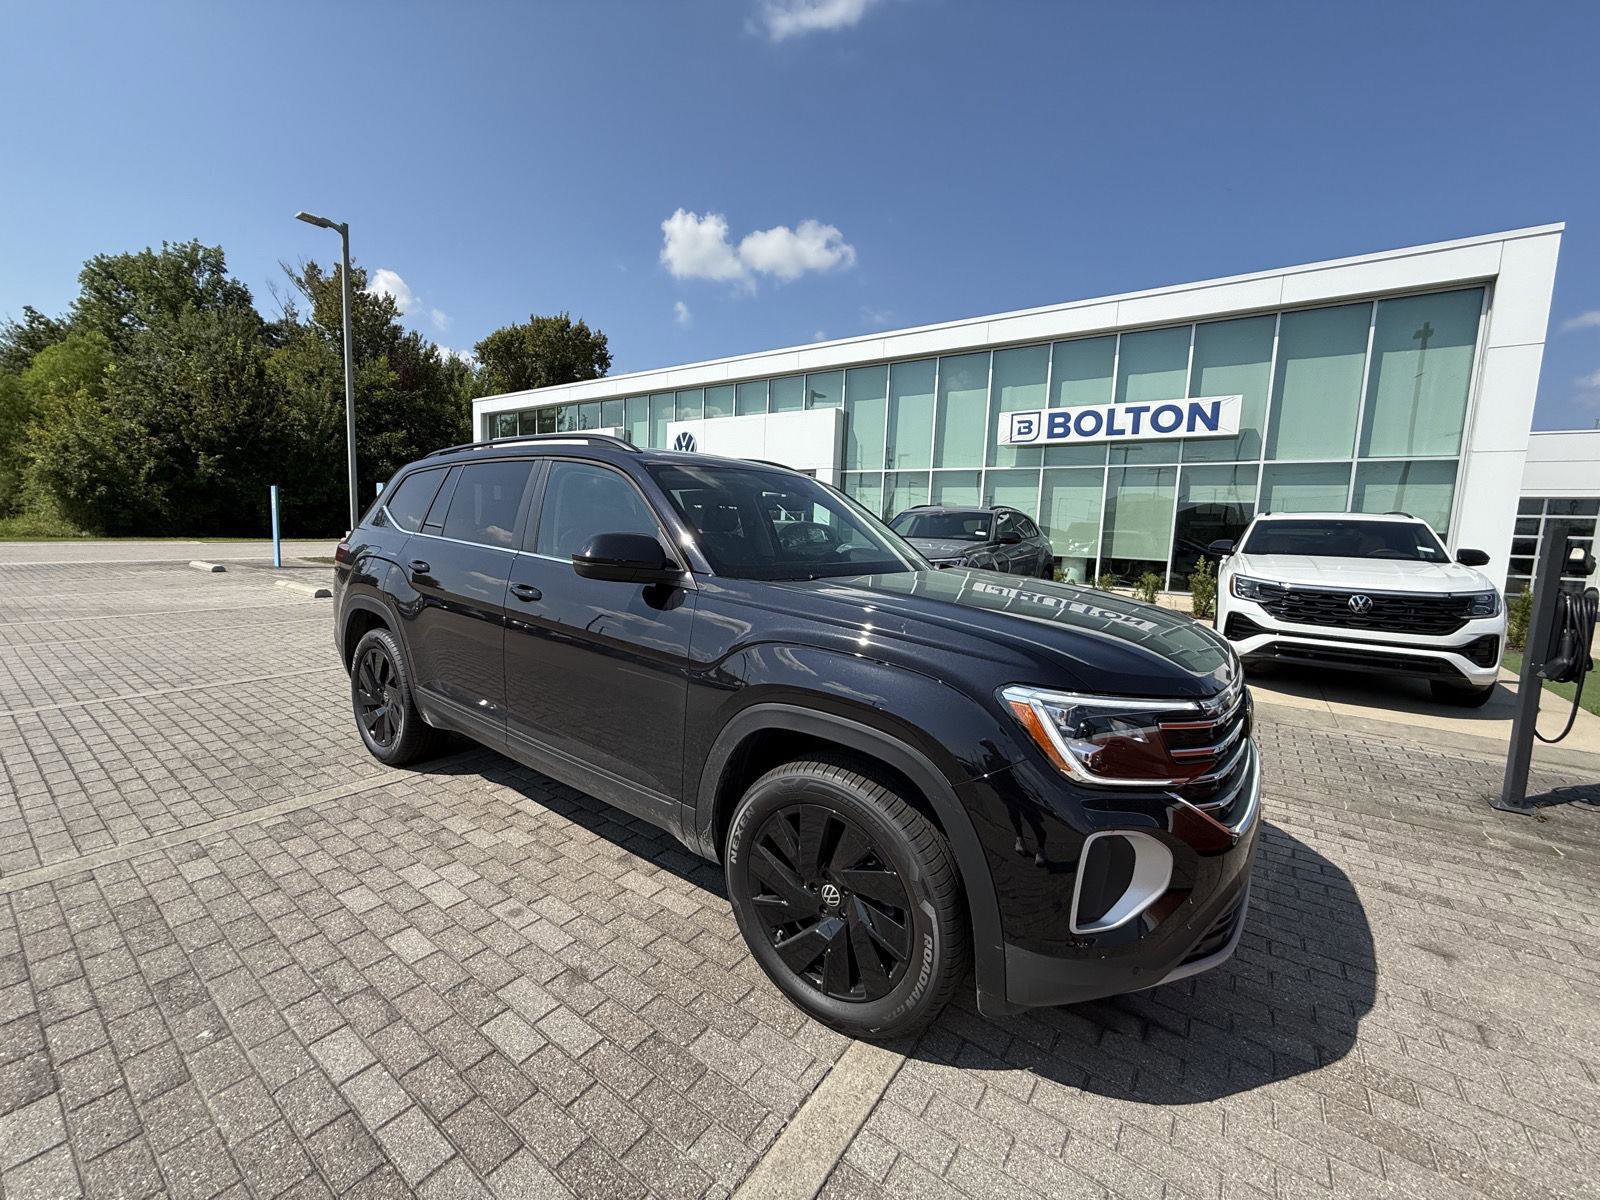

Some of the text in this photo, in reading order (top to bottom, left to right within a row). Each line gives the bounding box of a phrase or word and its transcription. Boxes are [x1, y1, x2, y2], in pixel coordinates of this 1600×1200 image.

[1046, 400, 1222, 440] BOLTON
[730, 805, 756, 865] NEXEN
[904, 932, 934, 1010] ROADIAN
